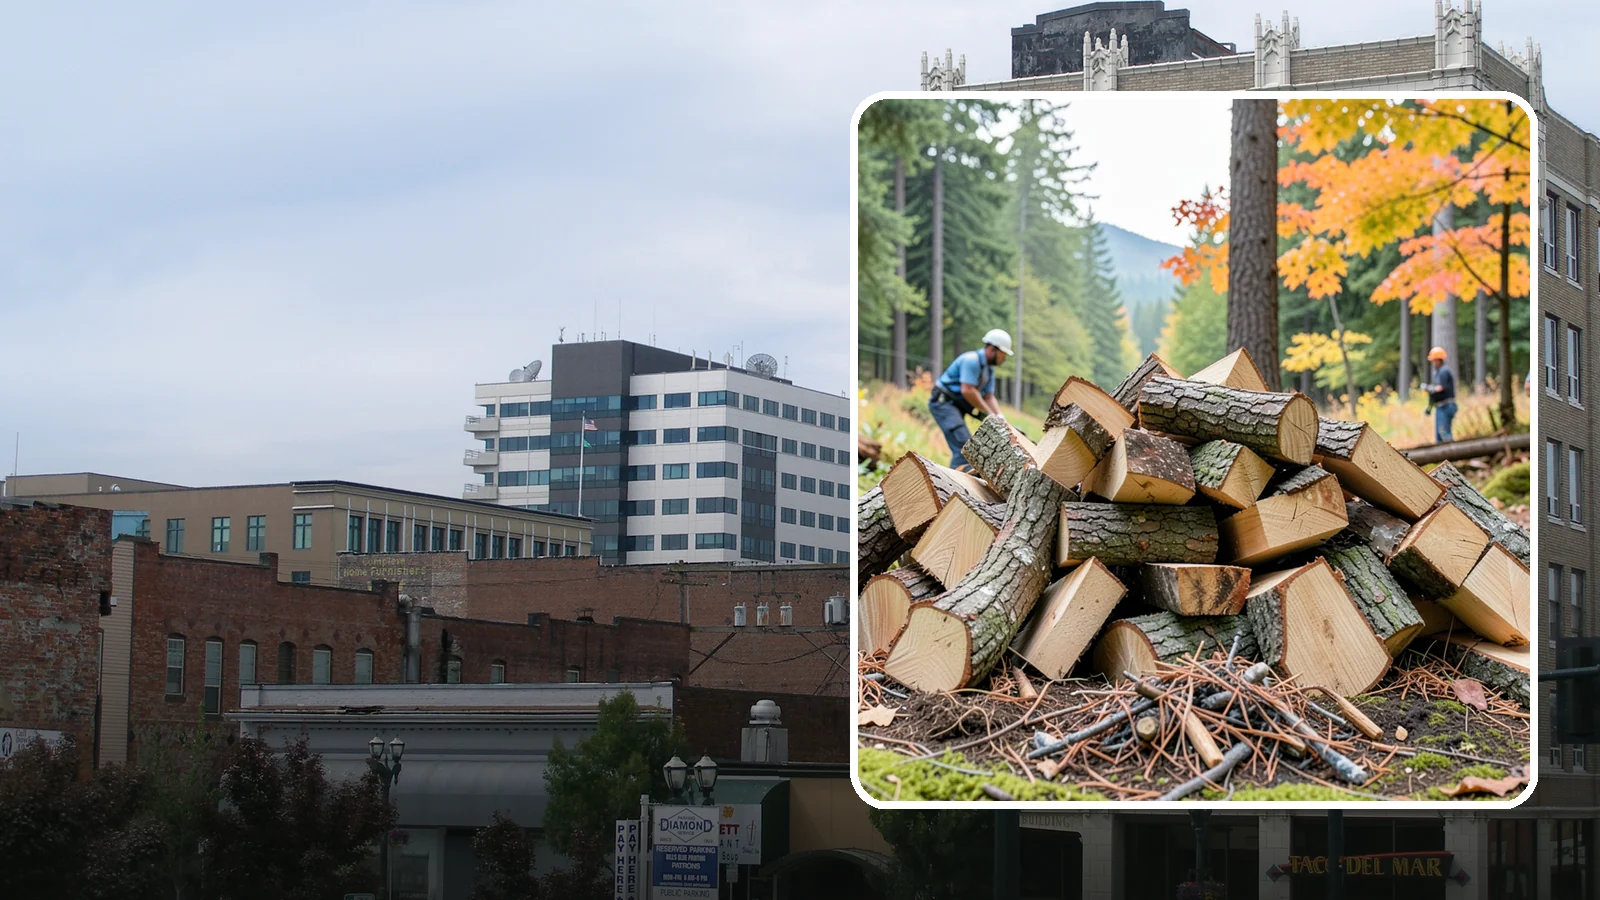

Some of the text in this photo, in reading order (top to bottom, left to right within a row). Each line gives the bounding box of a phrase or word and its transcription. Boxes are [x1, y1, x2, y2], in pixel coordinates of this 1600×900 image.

[343, 566, 427, 577] Home Furnishers
[660, 818, 713, 833] DIAMOND
[1022, 815, 1069, 828] BUILDING
[656, 845, 716, 854] RESERVED PARKING
[616, 825, 625, 893] PAY HERE
[627, 824, 637, 893] PAY HERE
[721, 851, 739, 862] Soup
[671, 862, 701, 870] PATRONS
[1289, 855, 1442, 876] TAC DEL MAR
[660, 888, 710, 898] PUBLIC PARKING
